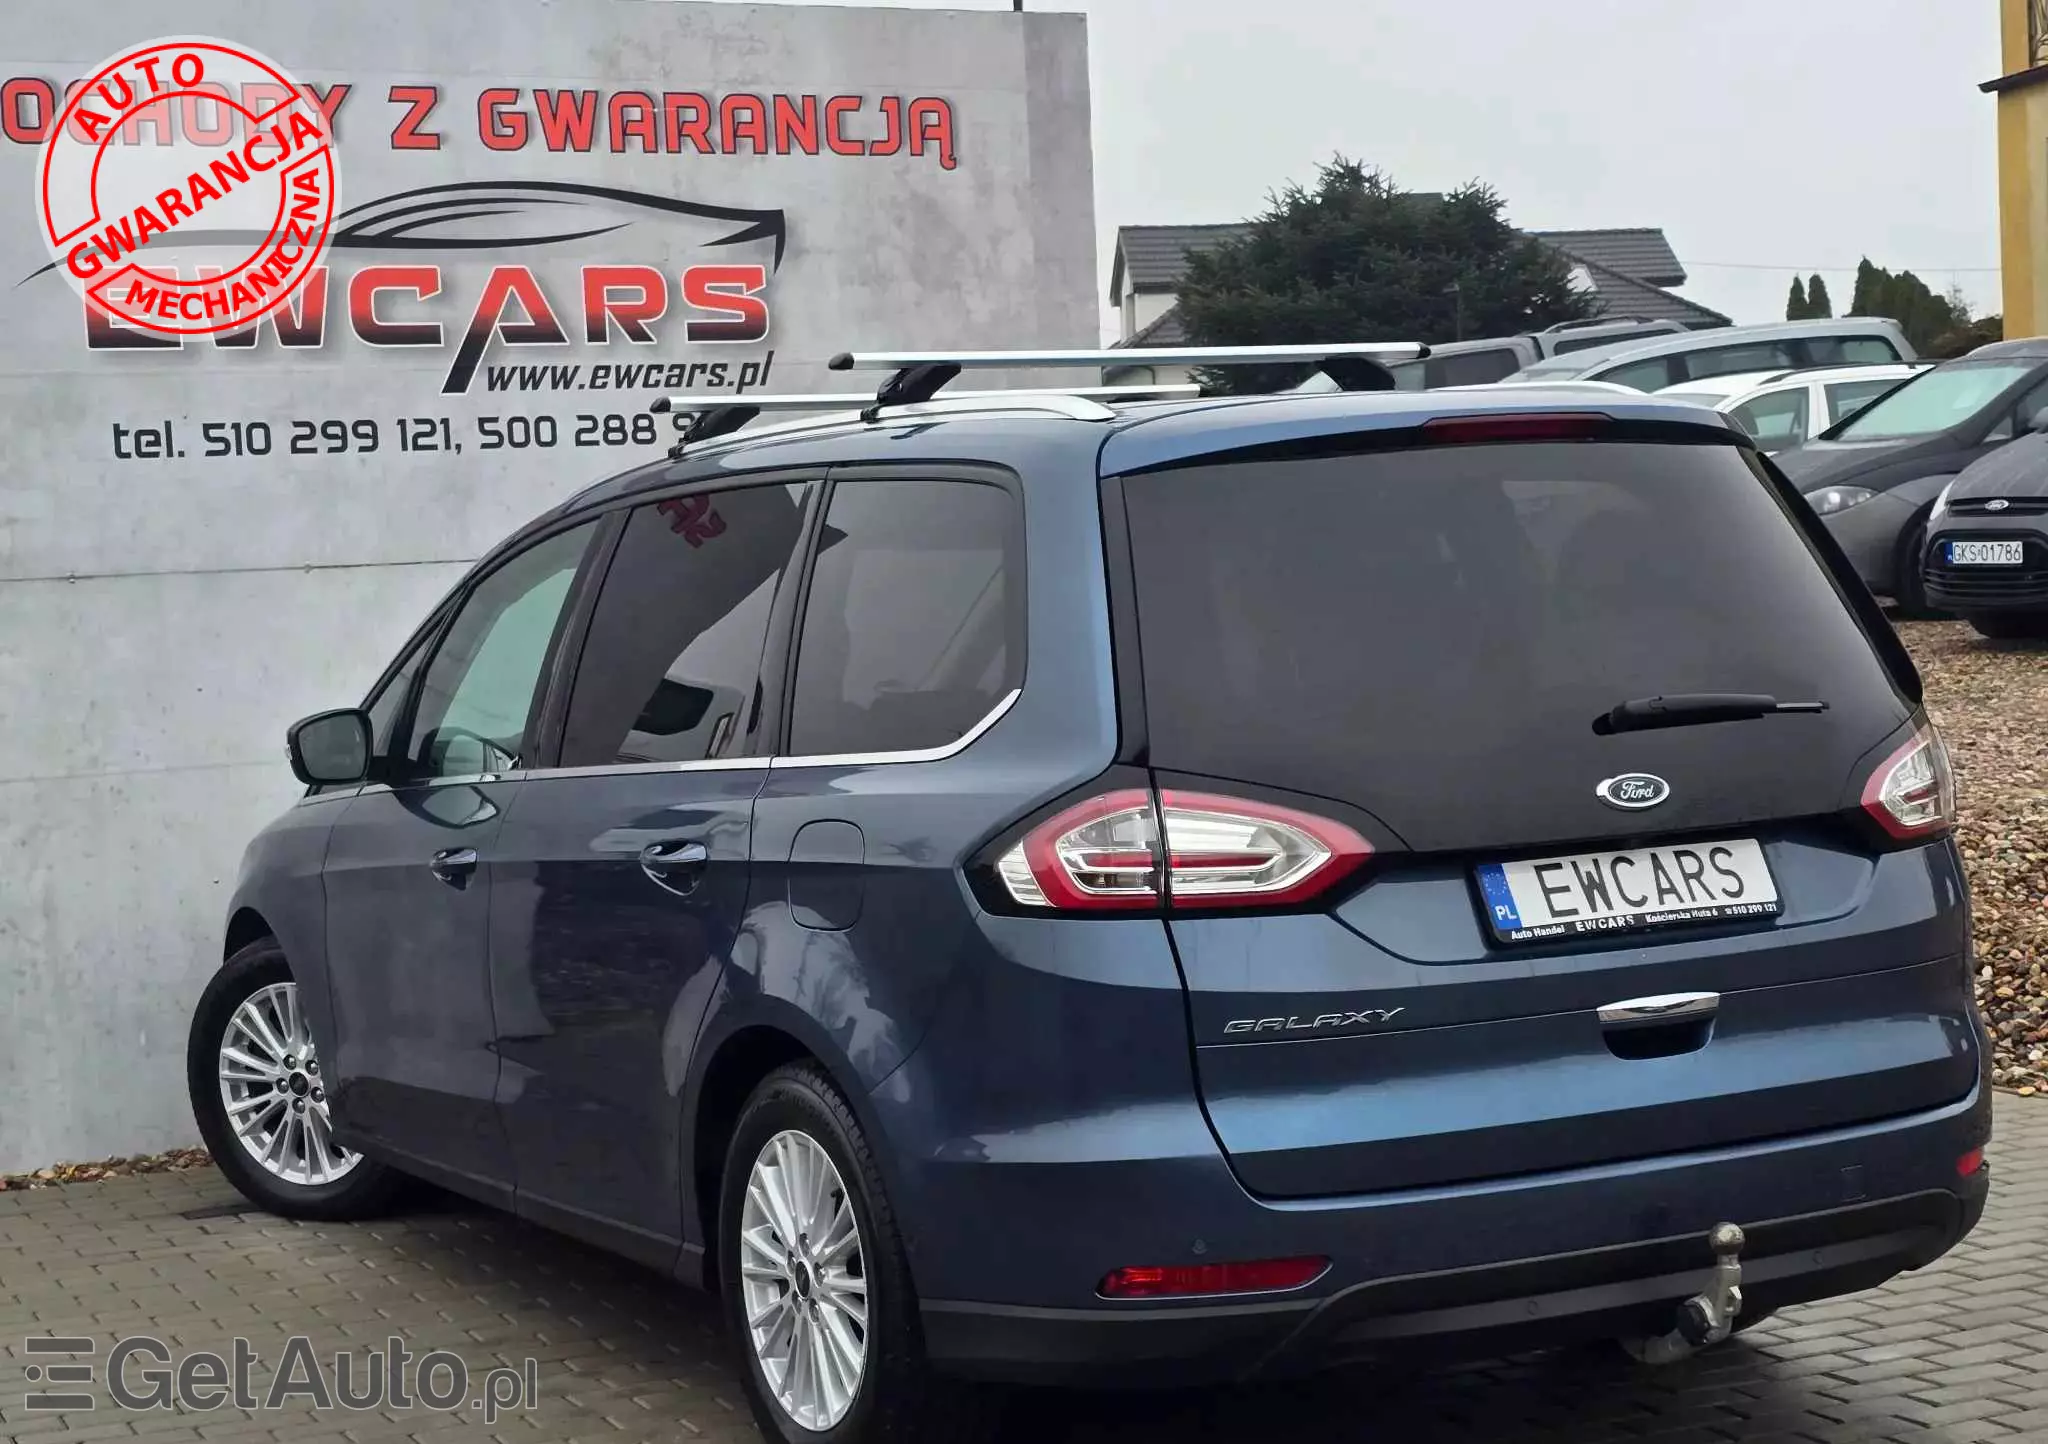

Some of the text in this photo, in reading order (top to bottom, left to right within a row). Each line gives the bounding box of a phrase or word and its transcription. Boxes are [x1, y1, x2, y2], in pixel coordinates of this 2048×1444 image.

[388, 85, 442, 150] Z
[477, 88, 957, 170] GWARANCJĄ
[84, 264, 770, 396] EWCARS
[486, 350, 775, 394] www.ewcars.pl
[113, 419, 186, 459] tel.
[203, 421, 272, 457] 510
[290, 419, 380, 454] 299
[398, 417, 463, 455] 121,
[478, 415, 558, 449] 500
[574, 412, 658, 447] 288
[1620, 780, 1655, 799] Ford
[1533, 846, 1744, 919] EWCARS
[1495, 904, 1517, 922] PL
[1511, 929, 1533, 940] Auto
[1533, 926, 1565, 938] Handel
[1576, 915, 1635, 932] EWCARS
[1223, 1007, 1406, 1034] GALAXY
